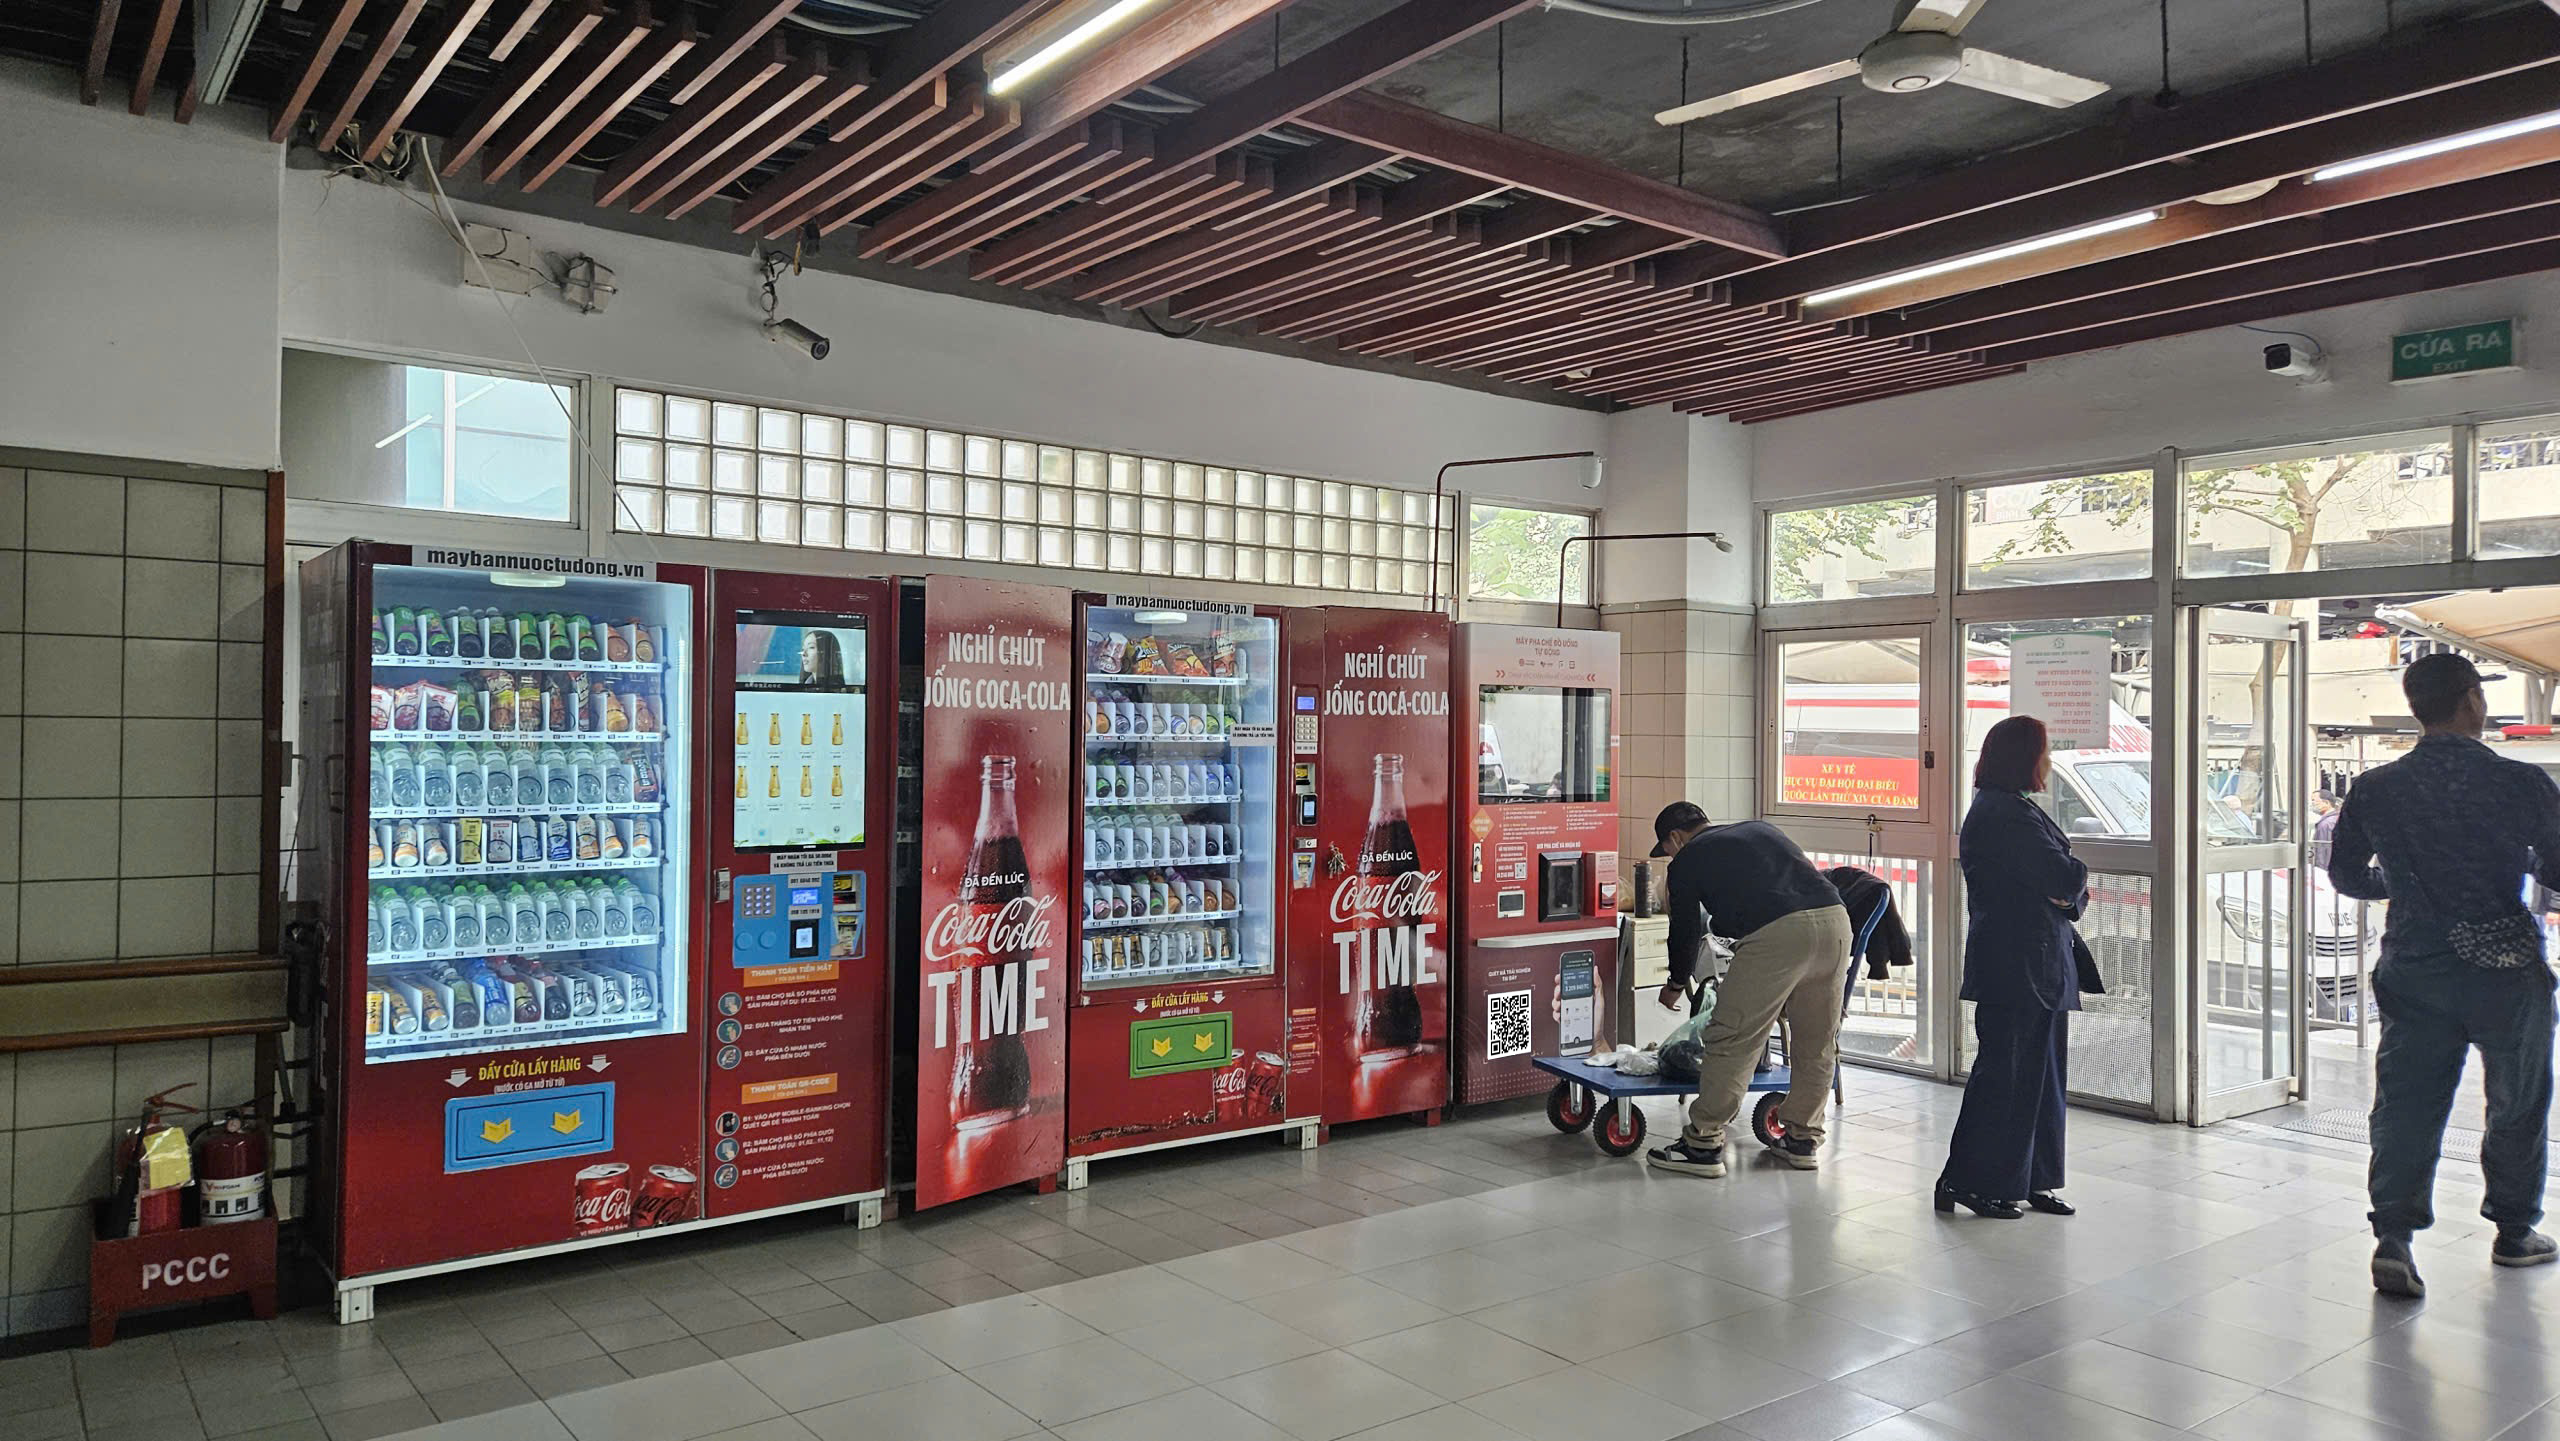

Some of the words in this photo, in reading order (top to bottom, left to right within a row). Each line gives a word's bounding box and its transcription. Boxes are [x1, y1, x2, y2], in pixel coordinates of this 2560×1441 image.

[2400, 334, 2456, 360] CỬA
[2466, 329, 2503, 351] RA
[2432, 359, 2468, 373] EXIT
[427, 549, 645, 578] maybannuoctudong.vn
[1115, 594, 1248, 616] maybannuoctudong.vn
[948, 624, 995, 664] NGHỈ
[998, 628, 1046, 668] CHÚT
[1344, 645, 1383, 679] NGHỈ
[1387, 647, 1427, 679] CHÚT
[975, 679, 1071, 711] COCA-COLA
[1367, 689, 1449, 716] COCA-COLA
[1822, 764, 1834, 774] XE
[1836, 764, 1842, 774] Y
[1844, 762, 1856, 775] TẾ
[1784, 776, 1803, 788] HỤC
[1805, 778, 1817, 789] VỤ
[1819, 779, 1836, 790] ĐẠI
[1837, 779, 1855, 790] HỘI
[1857, 780, 1874, 791] ĐẠI
[1853, 793, 1869, 804] XIV
[1362, 853, 1374, 863] ĐÃ
[1376, 850, 1393, 862] ĐẾN
[1395, 851, 1413, 862] LÚC
[964, 874, 980, 888] ĐÃ
[981, 871, 1004, 887] ĐẾN
[1005, 871, 1025, 885] LÚC
[1332, 923, 1438, 995] TIME
[928, 958, 1050, 1049] TIME
[1179, 991, 1190, 1006] LẤY
[1191, 991, 1209, 1004] HÀNG
[478, 1060, 501, 1081] ĐẨY
[503, 1058, 526, 1079] CỬA
[527, 1055, 549, 1076] LẤY
[551, 1055, 581, 1074] HÀNG
[141, 1252, 230, 1290] PCCC
